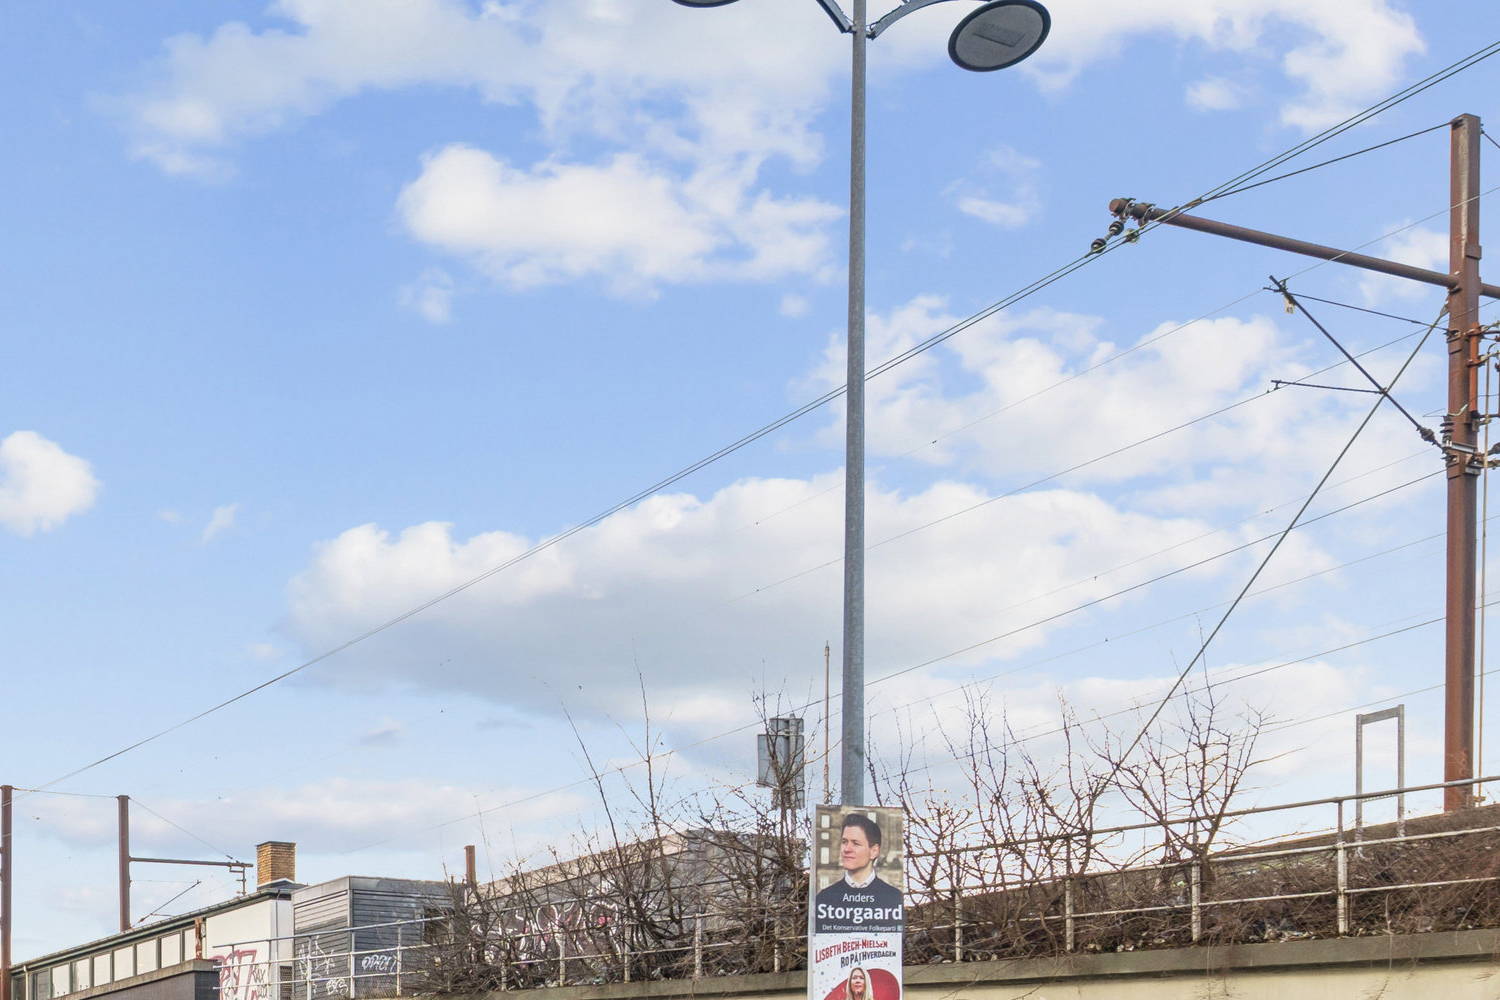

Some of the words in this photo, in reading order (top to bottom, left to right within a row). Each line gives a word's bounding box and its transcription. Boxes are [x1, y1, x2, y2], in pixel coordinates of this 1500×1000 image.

[842, 893, 875, 903] Anders
[817, 903, 903, 924] Storgaard
[815, 943, 842, 964] LISBETH
[840, 956, 850, 969] RO
[850, 952, 859, 966] PÅ
[861, 950, 897, 961] HVERDAGEN
